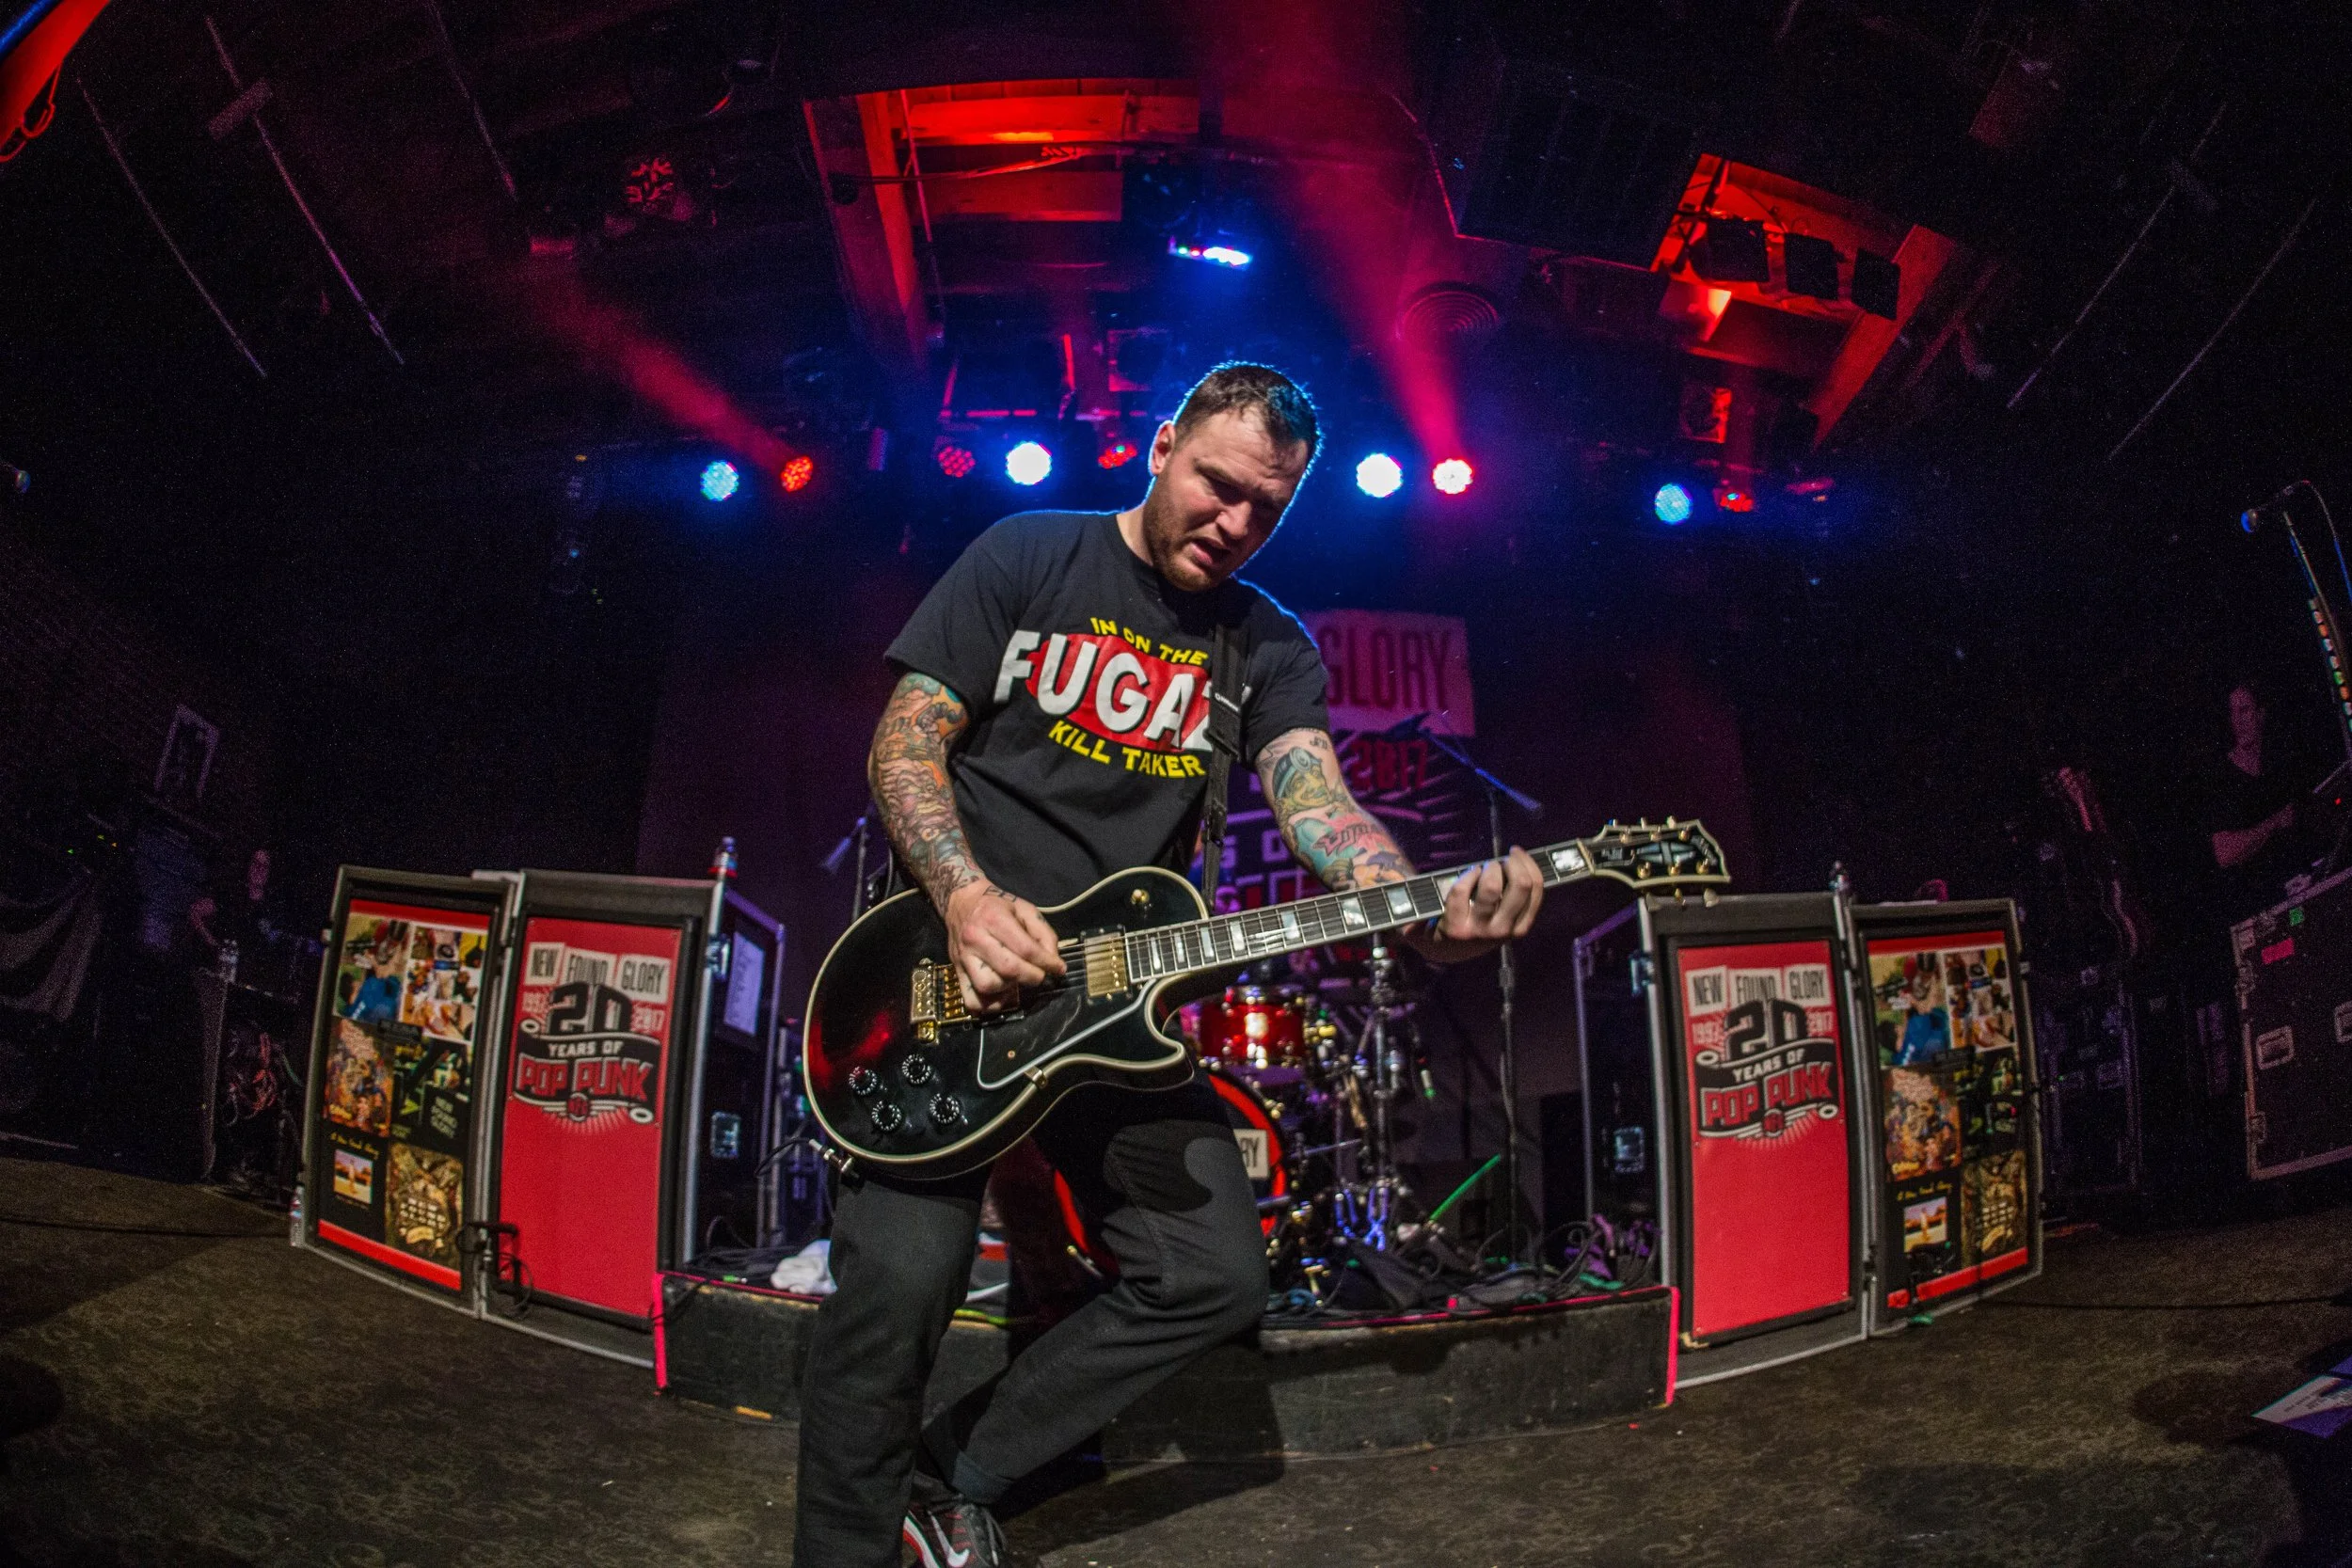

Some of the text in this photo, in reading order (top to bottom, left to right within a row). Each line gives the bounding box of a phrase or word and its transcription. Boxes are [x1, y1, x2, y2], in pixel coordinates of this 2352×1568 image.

[1090, 617, 1209, 666] IN ON THE
[993, 629, 1252, 752] FUGA
[1320, 625, 1452, 711] GLORY
[1048, 720, 1205, 778] KILL TAKER
[531, 948, 665, 994] NEW FOUND GLORY
[1692, 970, 1825, 1006] NEW FOUND GLORY
[548, 1039, 624, 1057] YEARS OF
[1732, 1048, 1806, 1083] YEARS OF
[516, 1053, 654, 1102] POP PUNK
[1701, 1061, 1834, 1128] POP PUNK
